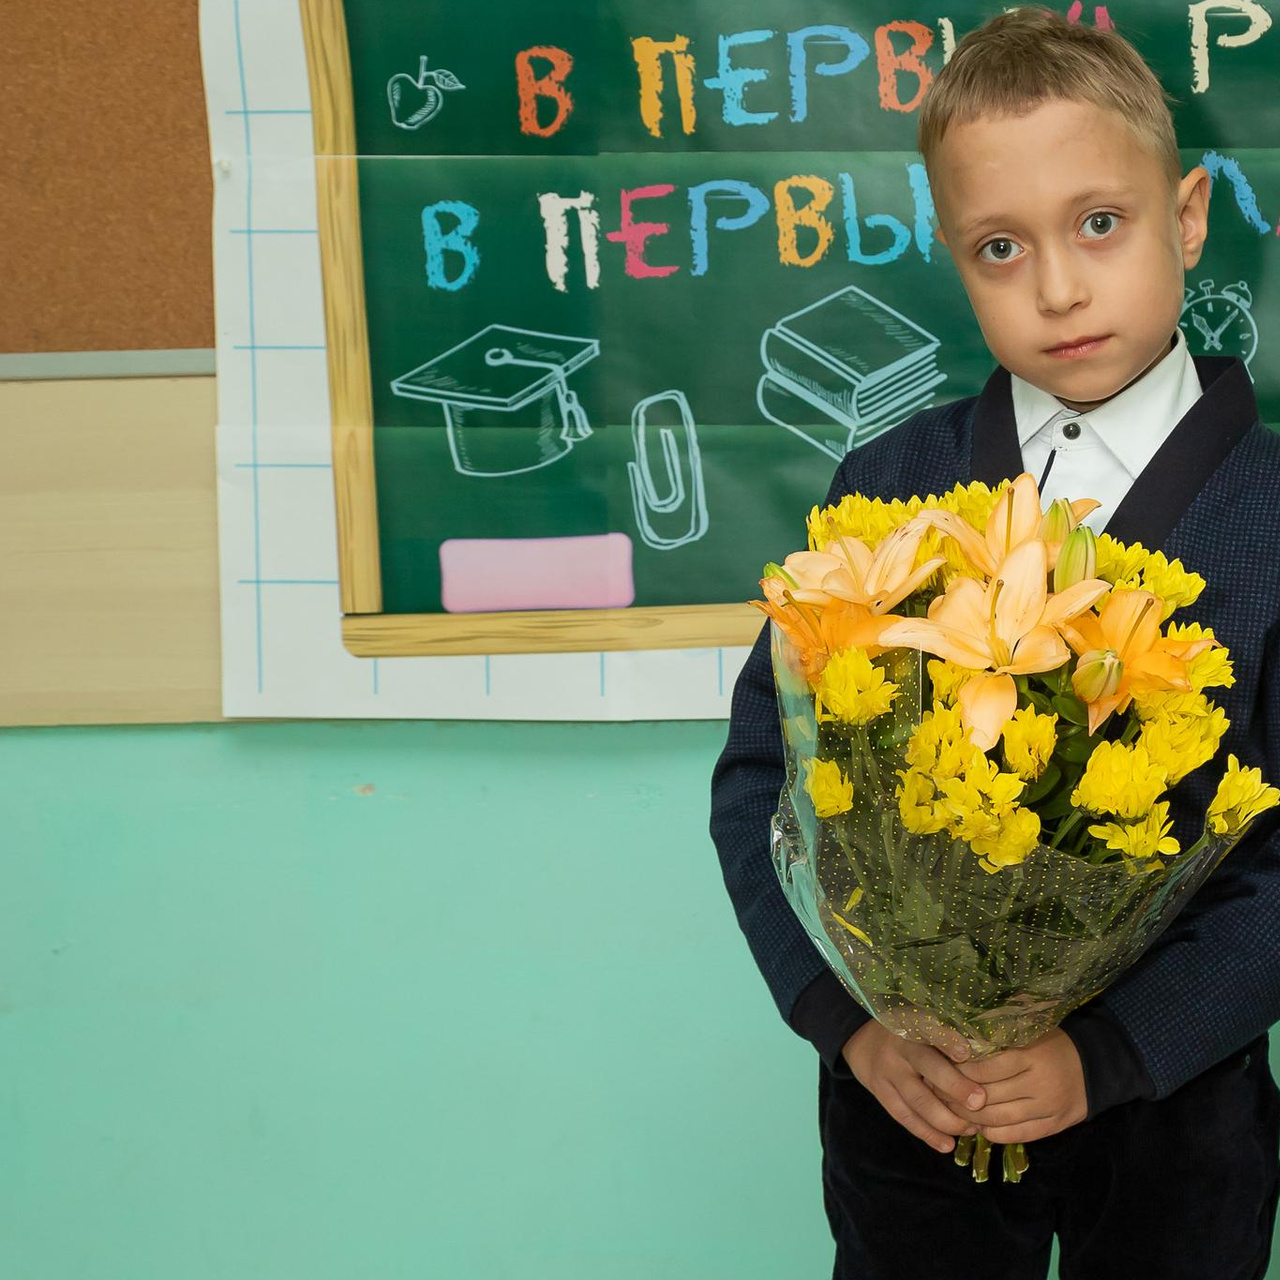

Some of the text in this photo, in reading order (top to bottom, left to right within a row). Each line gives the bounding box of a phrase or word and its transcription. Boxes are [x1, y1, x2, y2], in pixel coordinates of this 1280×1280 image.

[514, 45, 575, 138] В
[630, 0, 1116, 138] ПЕРВ
[420, 199, 481, 293] В
[537, 162, 936, 293] ПЕРВЫ
